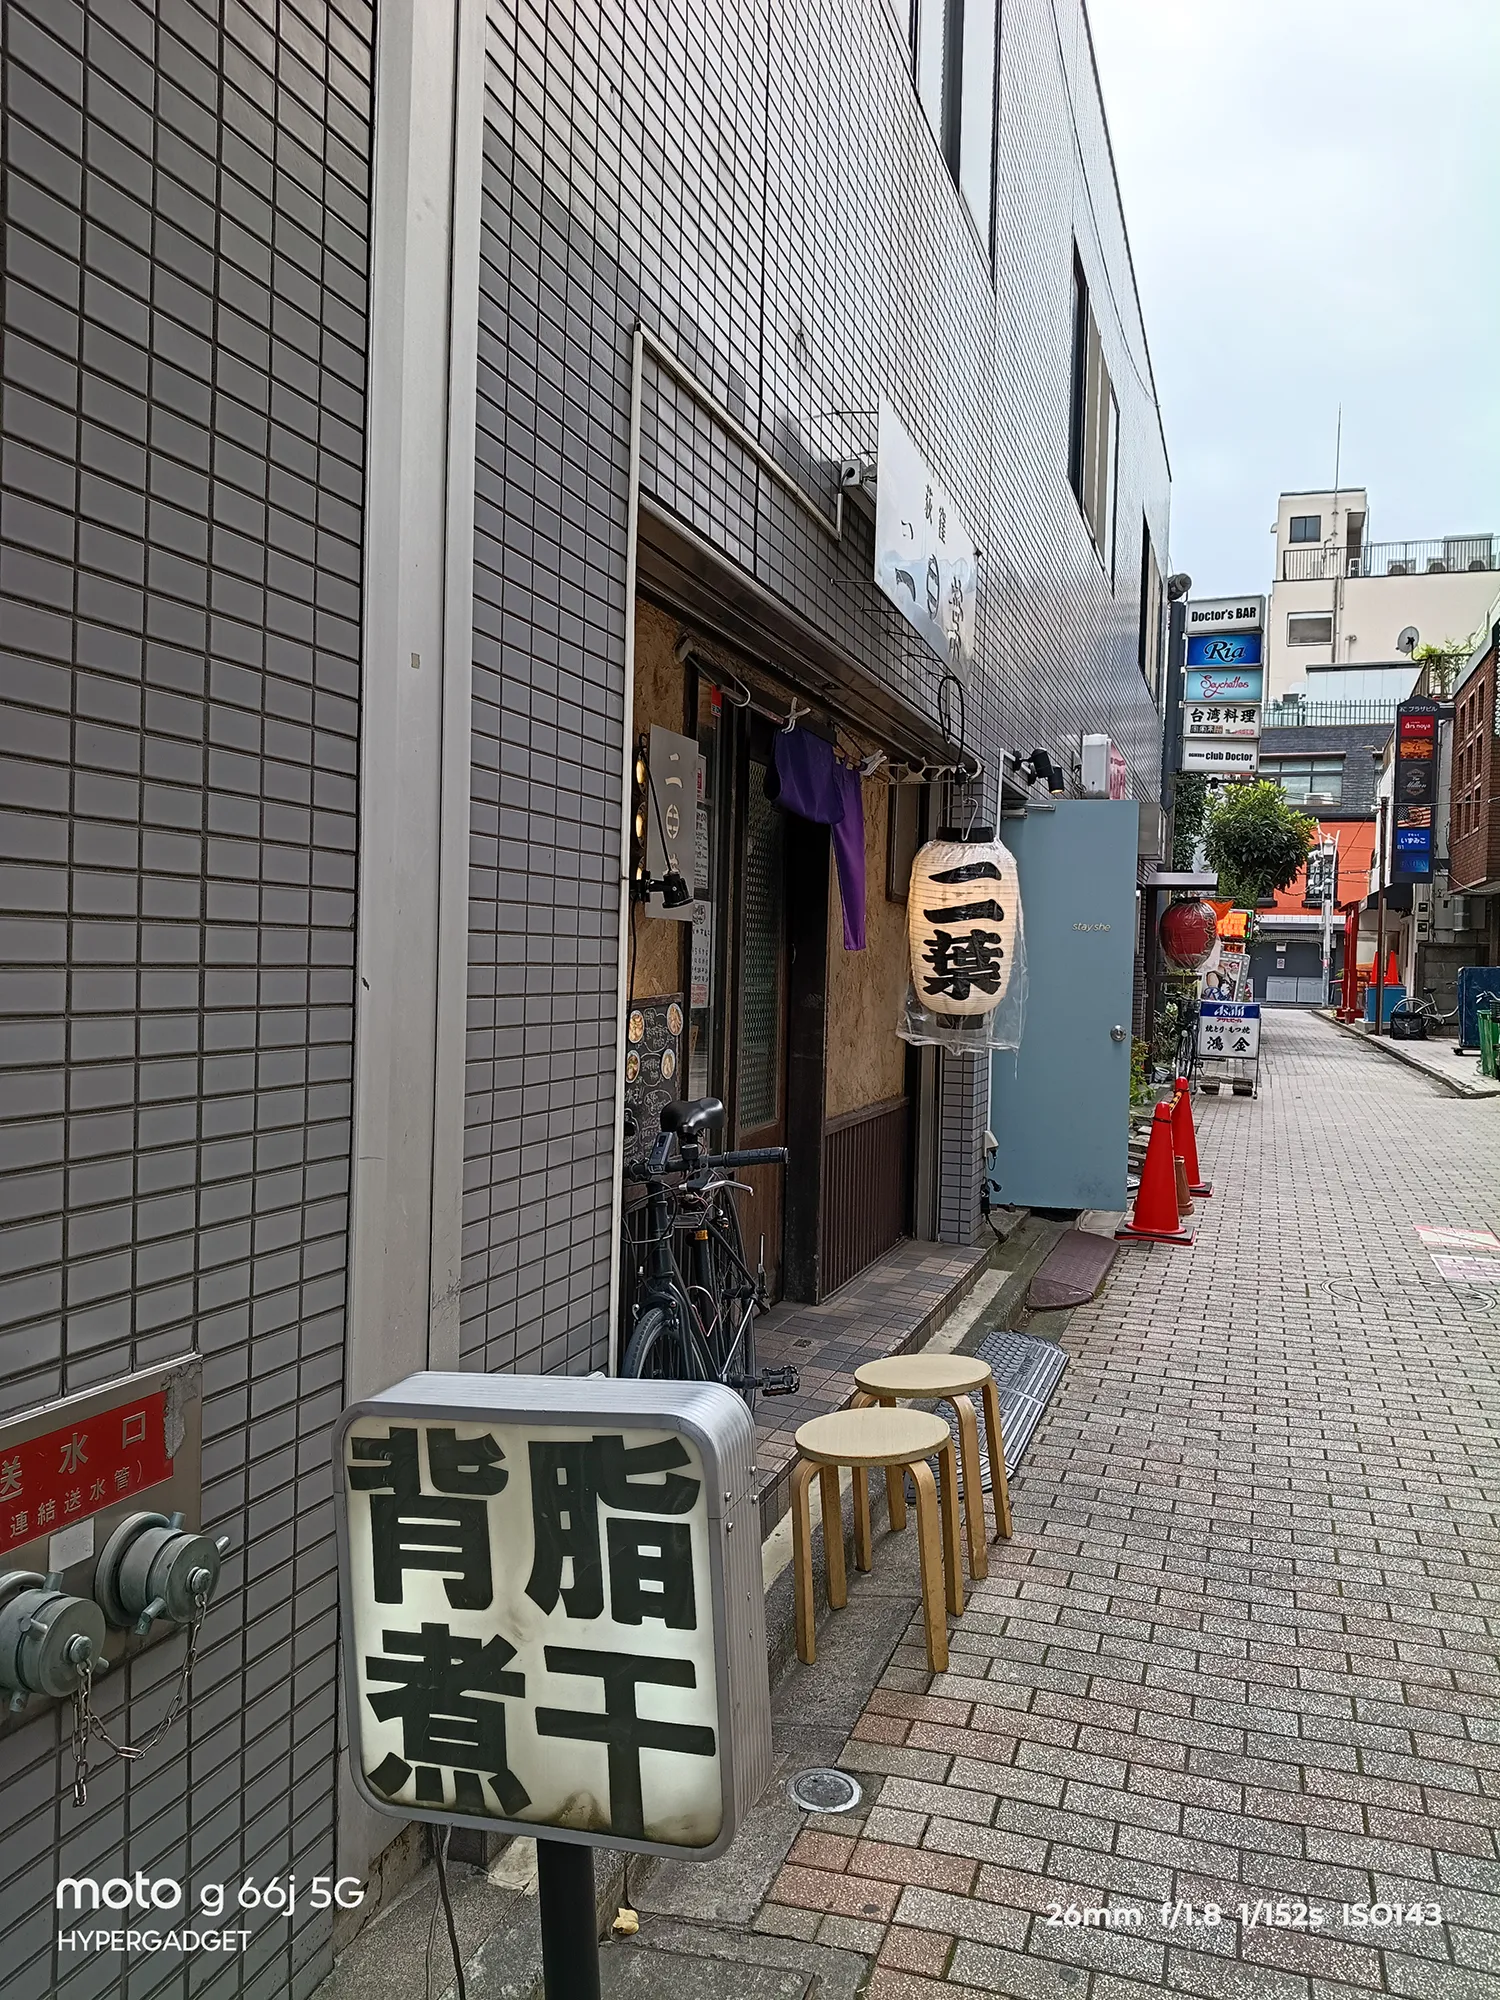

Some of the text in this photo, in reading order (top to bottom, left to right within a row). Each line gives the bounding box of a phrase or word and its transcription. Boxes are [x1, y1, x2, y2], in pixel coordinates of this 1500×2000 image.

[1191, 607, 1257, 622] Doctor's BAR
[1204, 640, 1246, 663] Ria
[1190, 707, 1257, 723] 台湾料理
[1205, 752, 1224, 761] club
[1225, 752, 1254, 762] Doctor
[1214, 1004, 1245, 1017] Asahi
[0, 1410, 146, 1501] 送水口
[347, 1427, 701, 1630] 背脂
[366, 1623, 716, 1836] 煮干
